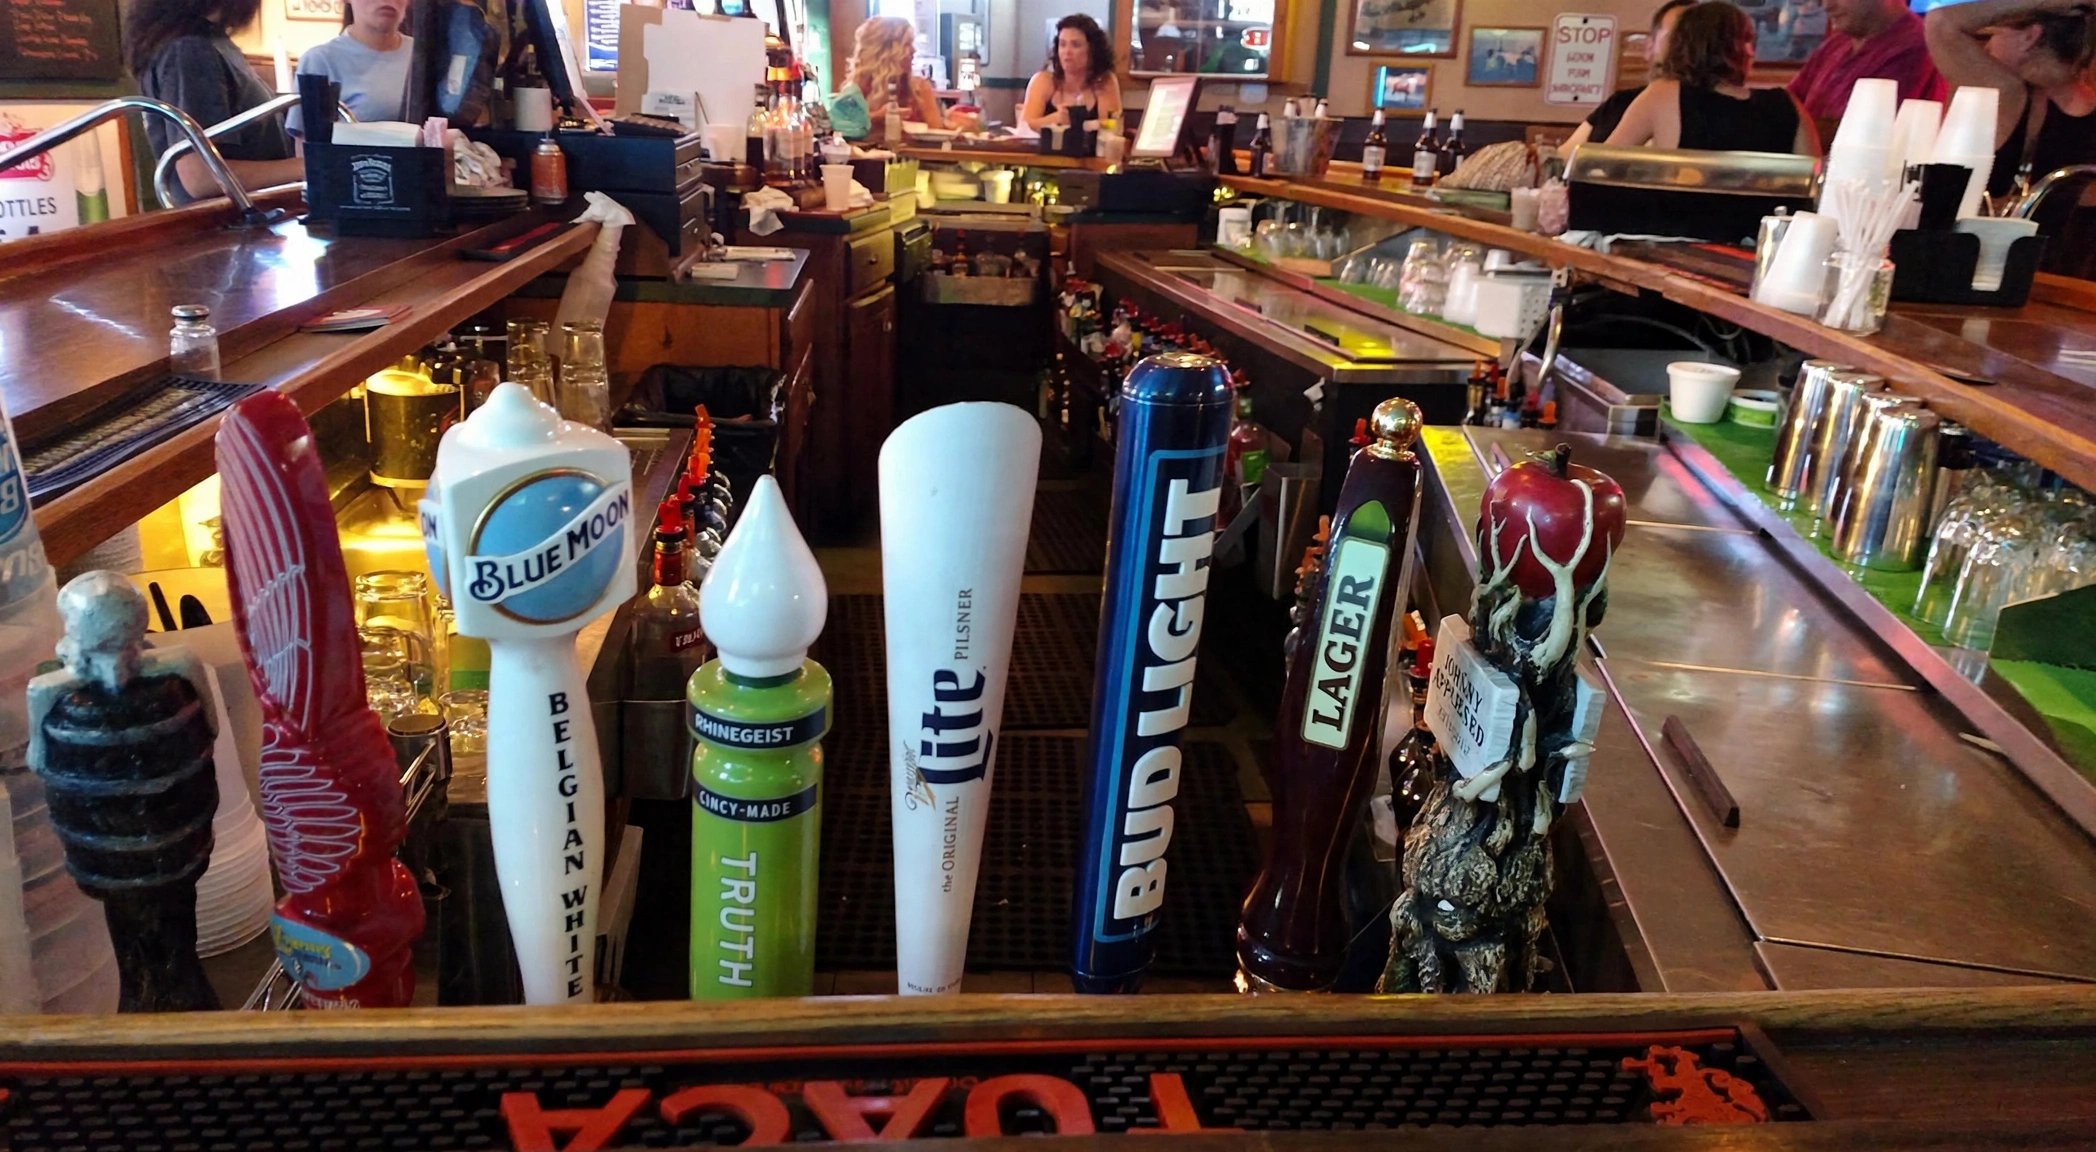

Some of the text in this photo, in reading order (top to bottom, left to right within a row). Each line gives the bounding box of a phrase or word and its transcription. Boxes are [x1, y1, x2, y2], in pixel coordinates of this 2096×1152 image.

[1559, 26, 1611, 44] STOP
[469, 490, 629, 601] BLUE MOON
[954, 588, 972, 660] PILSNER
[1311, 574, 1375, 732] LAGER
[695, 713, 795, 743] RHINEGEIST
[918, 669, 994, 785] Lite
[1113, 479, 1221, 919] BUD LIGHT
[548, 692, 588, 998] BELGIAN WHITE
[699, 790, 791, 818] CINCY-MADE
[942, 796, 959, 893] the ORIGINAL
[718, 852, 757, 987] TRUTH
